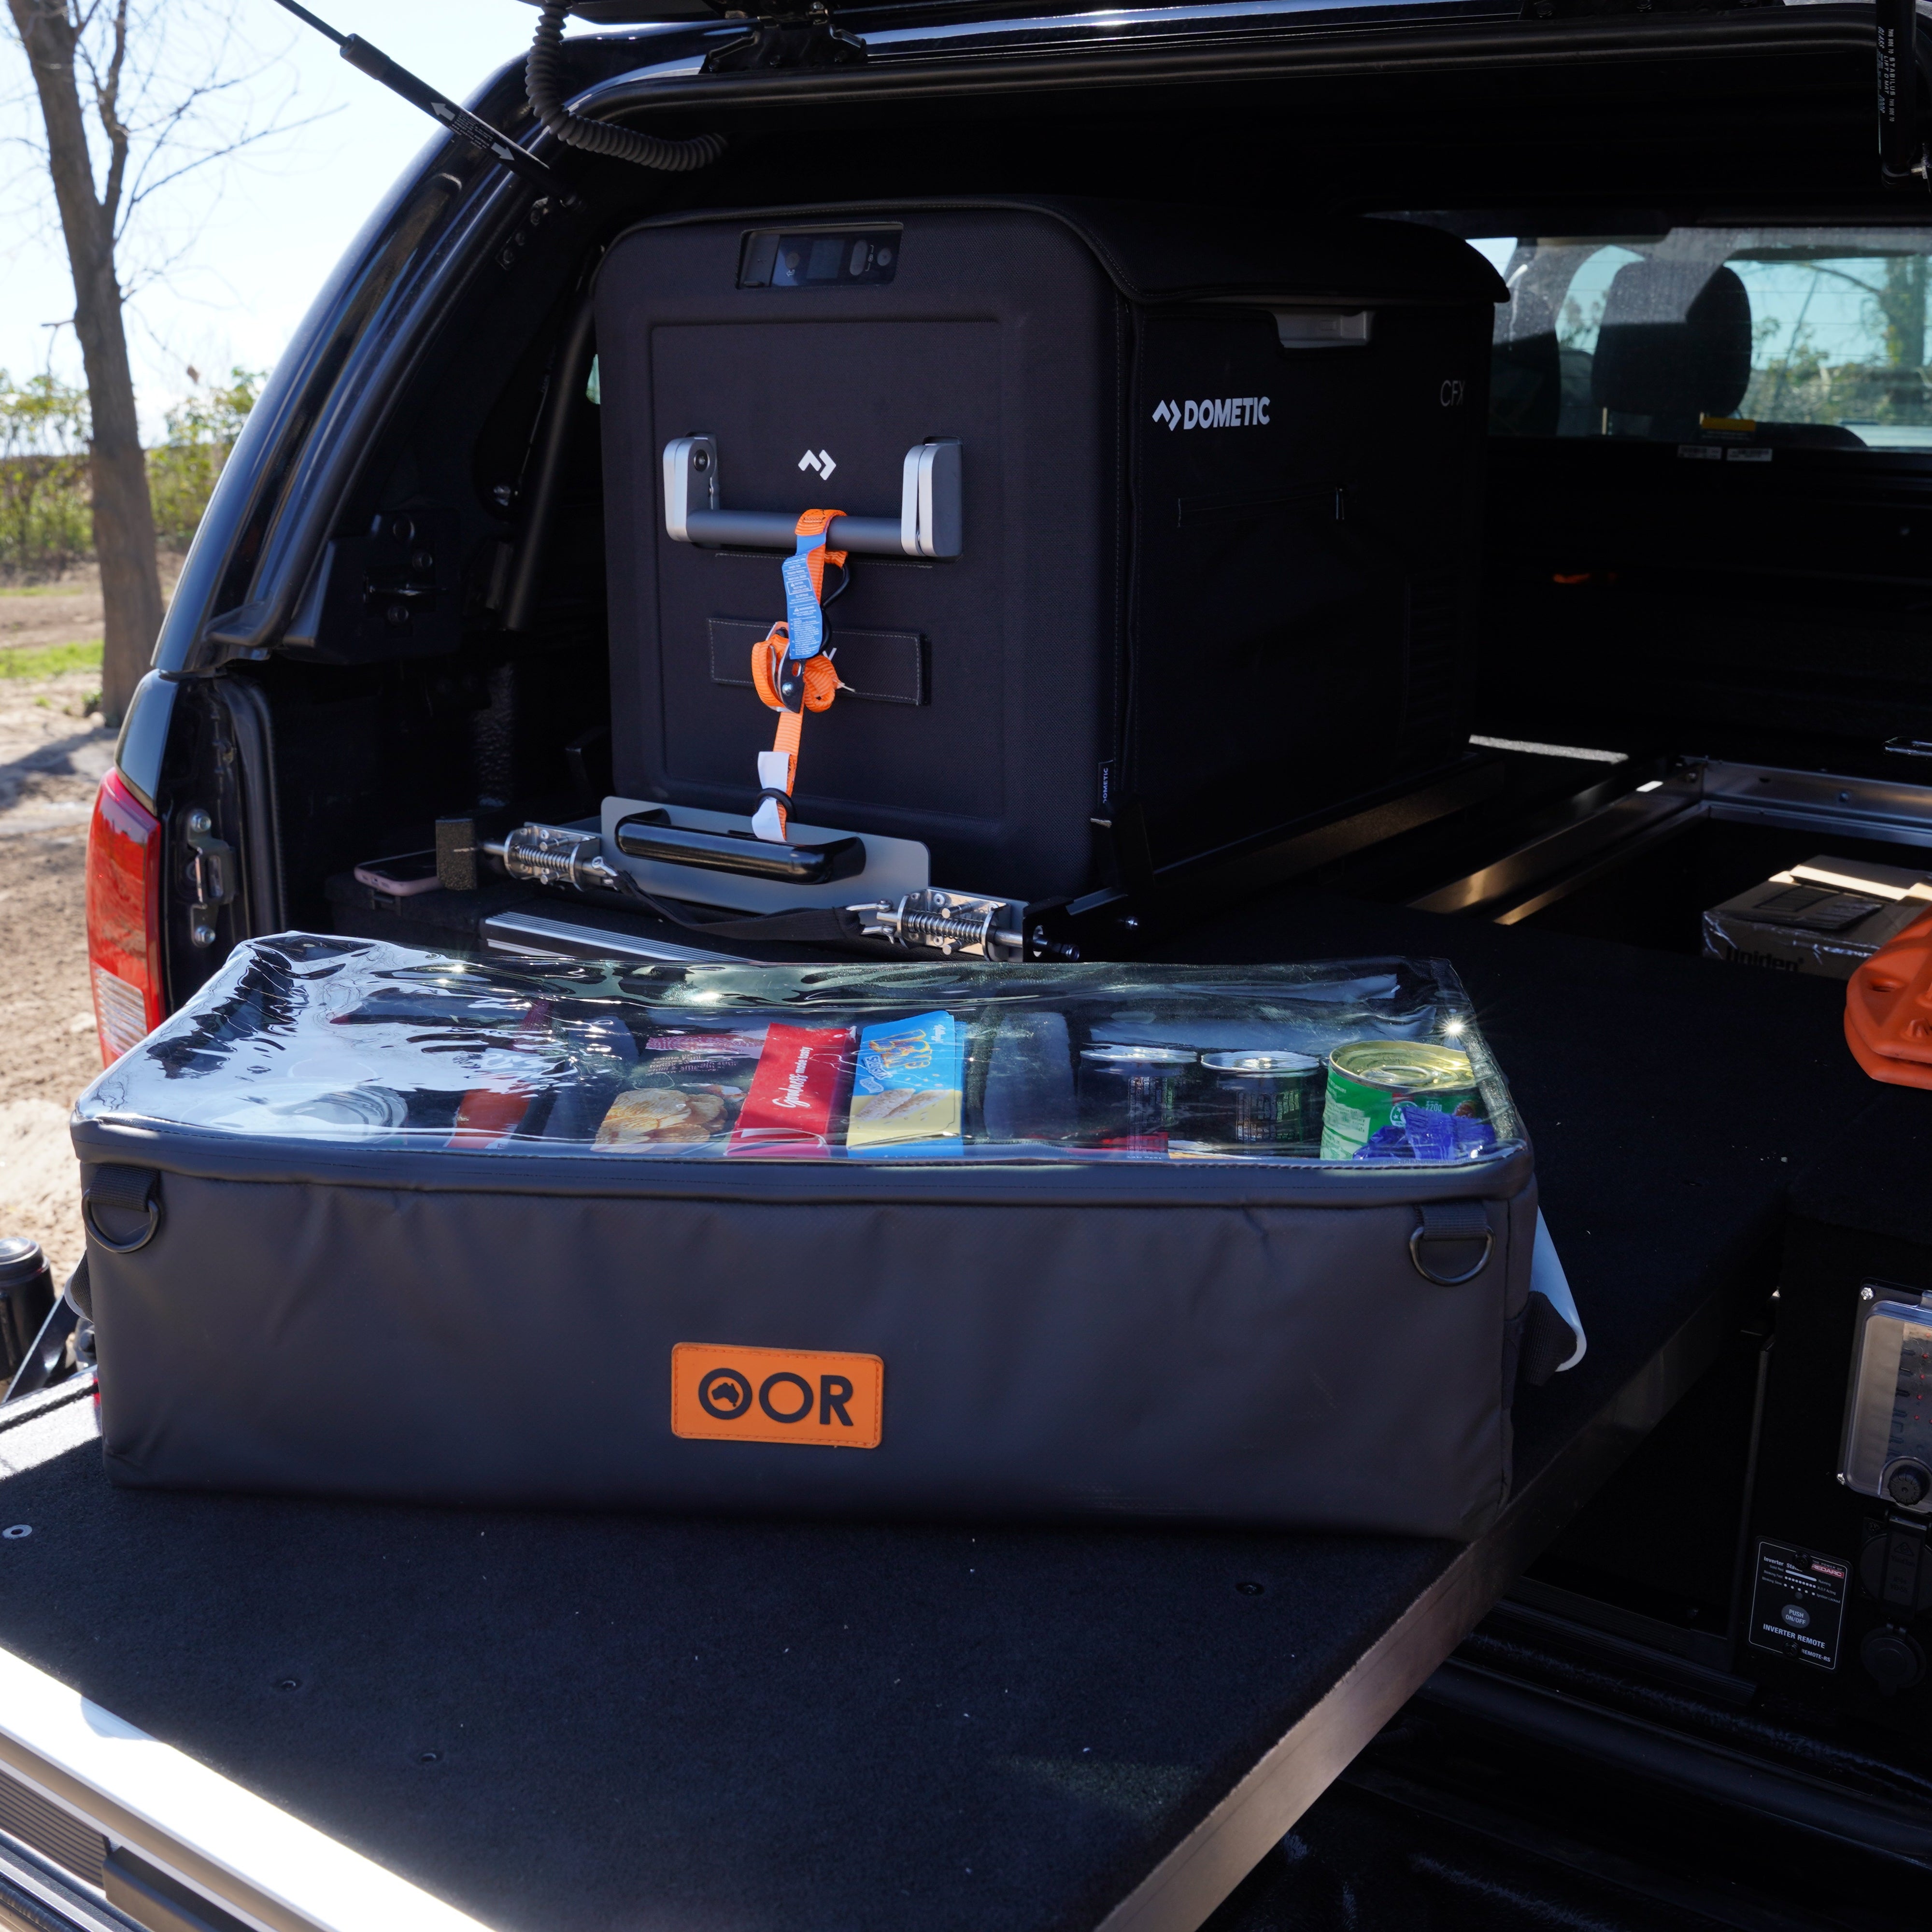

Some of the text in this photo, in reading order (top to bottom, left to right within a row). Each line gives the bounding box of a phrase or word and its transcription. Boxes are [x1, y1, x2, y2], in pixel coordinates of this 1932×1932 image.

[1440, 380, 1465, 407] CFX
[1184, 397, 1270, 430] DOMETIC
[772, 1046, 813, 1108] Goodness made tasty
[1763, 1556, 1784, 1566] Inverter
[1812, 1564, 1843, 1577] REDARC
[1785, 1615, 1806, 1625] ON/OFF
[1789, 1609, 1804, 1618] PUSH
[1763, 1623, 1826, 1648] INVERTER REMOTE
[1801, 1648, 1831, 1662] REMOTE-RS
